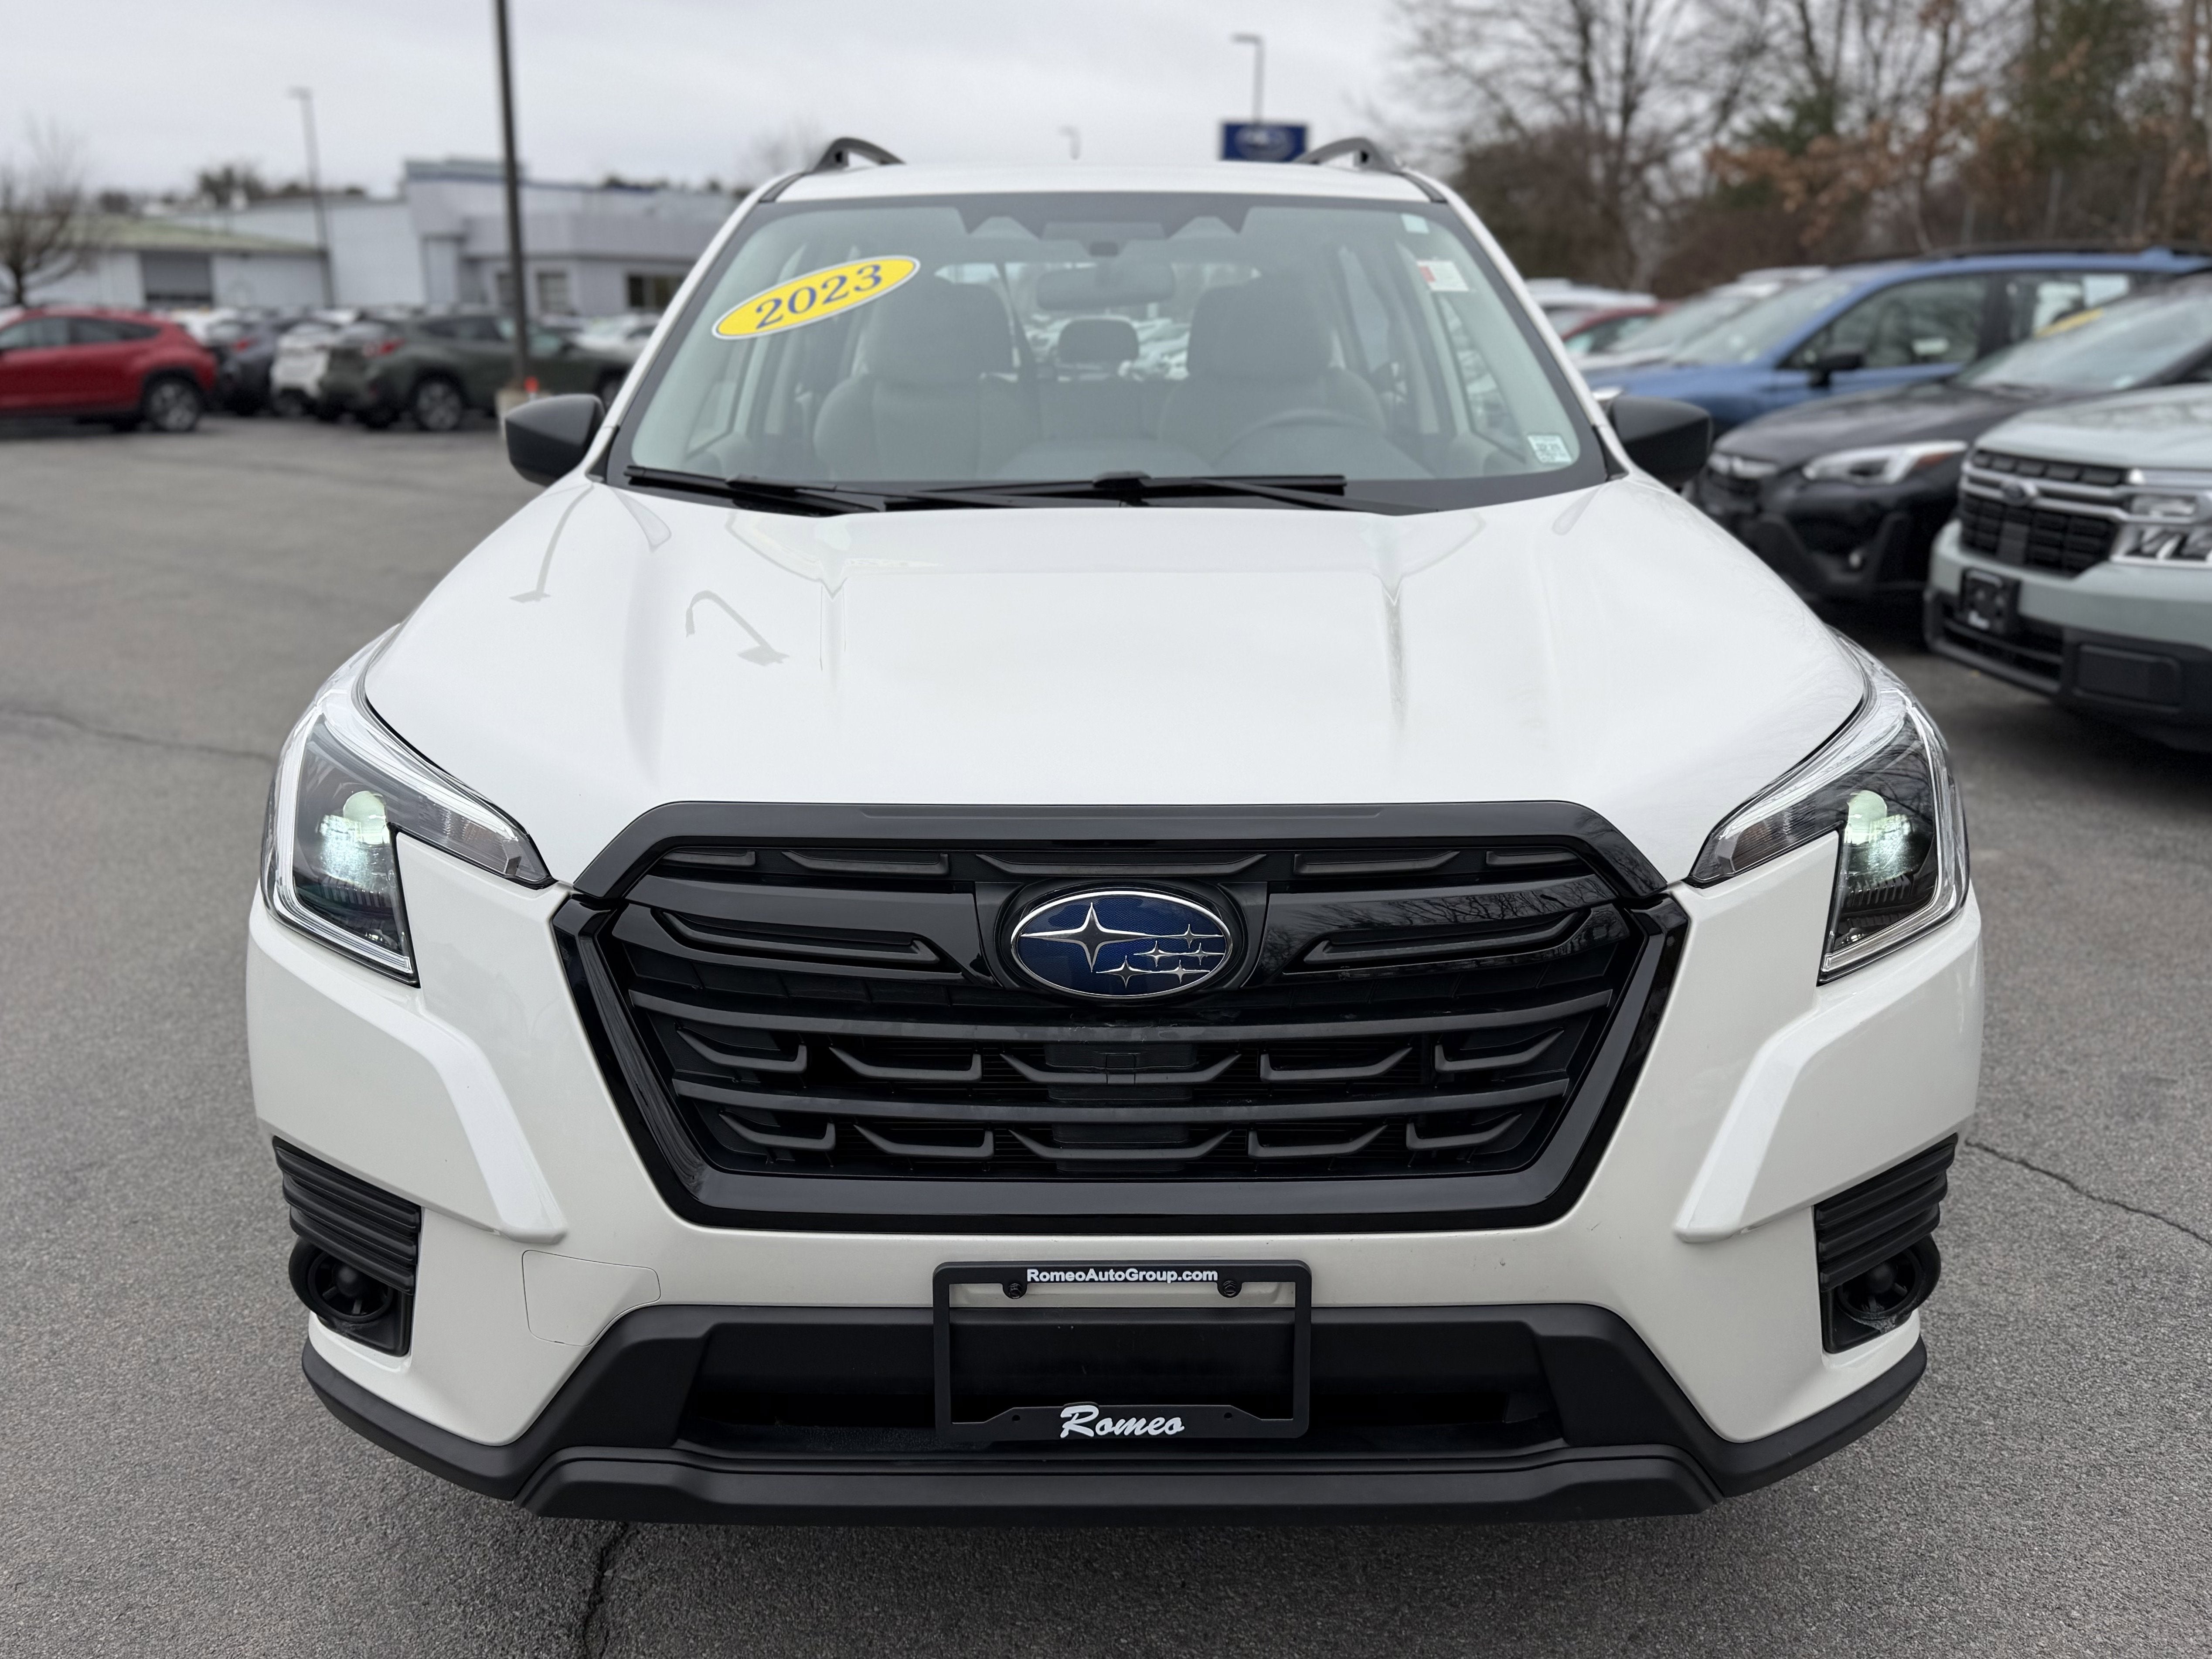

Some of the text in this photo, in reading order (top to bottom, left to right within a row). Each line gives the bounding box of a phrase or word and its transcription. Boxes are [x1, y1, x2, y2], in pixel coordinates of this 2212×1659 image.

[755, 265, 882, 329] 2023
[1027, 1269, 1218, 1284] RomeoAutoGroup.com
[1060, 1405, 1185, 1438] Romeo
